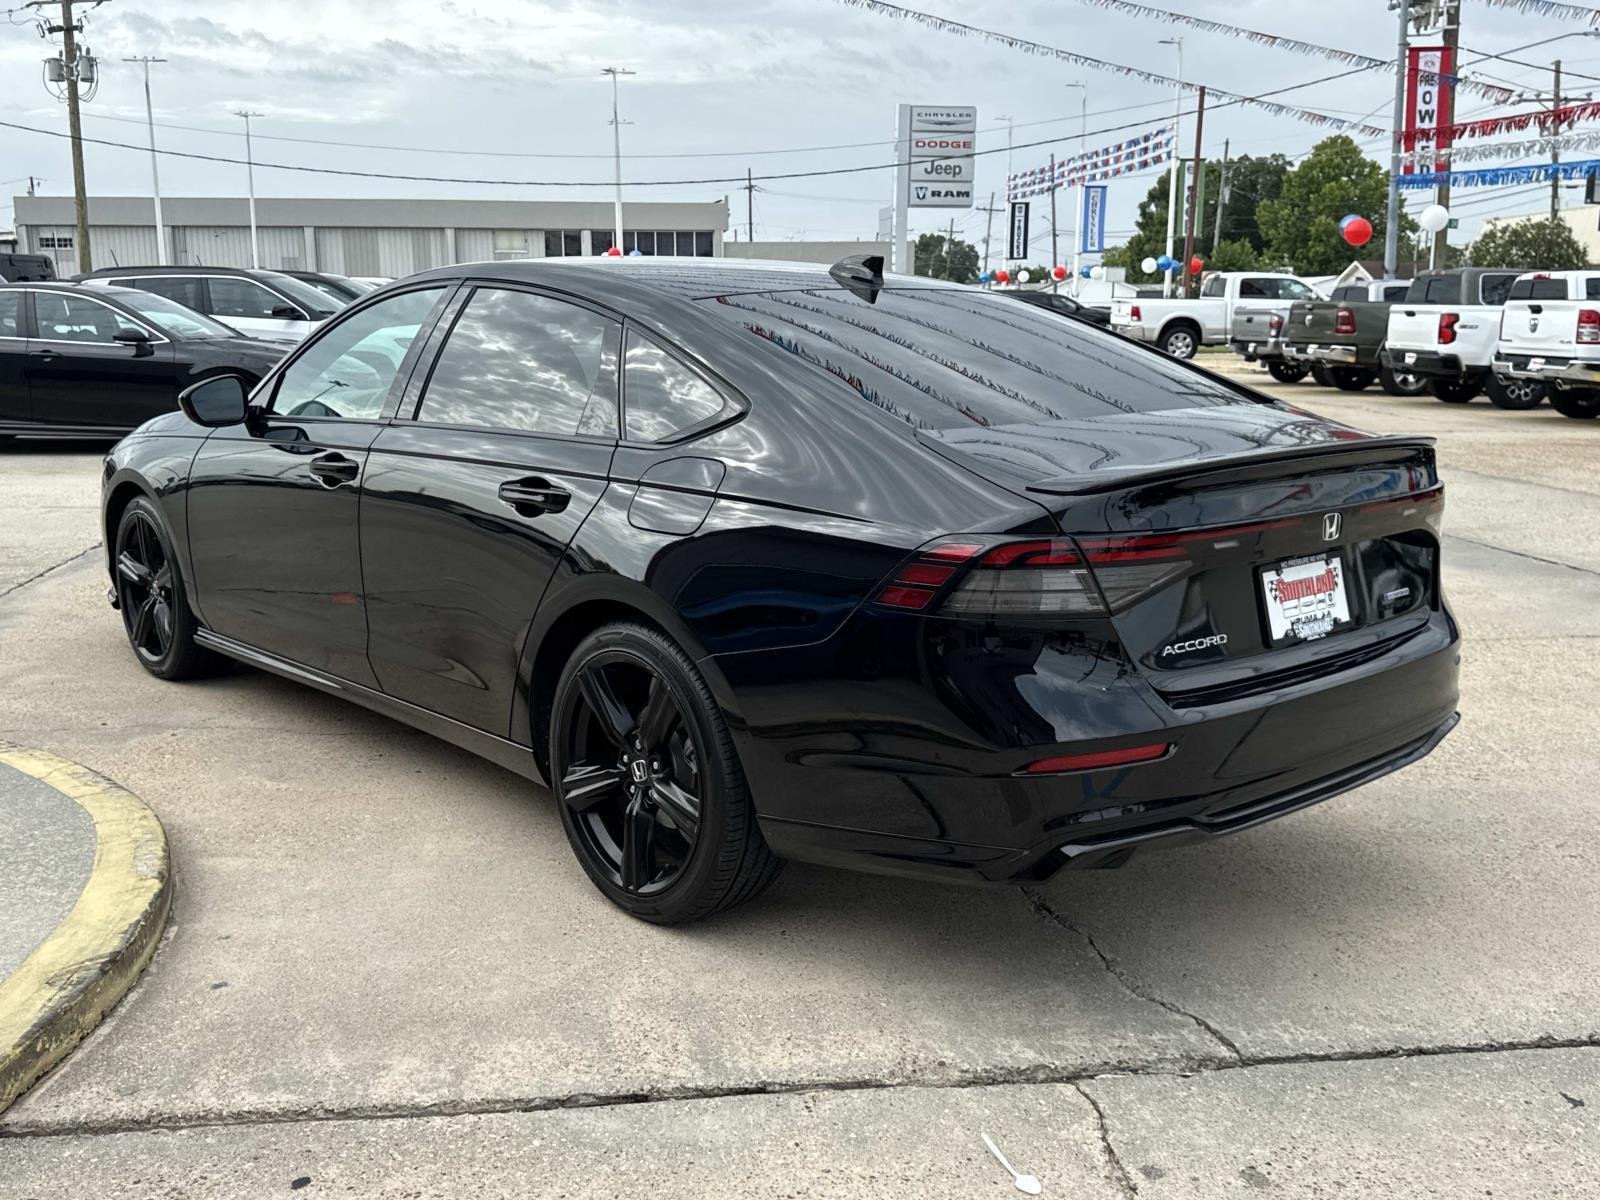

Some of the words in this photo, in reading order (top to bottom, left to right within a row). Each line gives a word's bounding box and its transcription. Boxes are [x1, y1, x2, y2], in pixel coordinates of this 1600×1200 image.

[915, 140, 973, 149] DODGE
[924, 160, 962, 178] Jeep
[931, 190, 971, 198] RAM
[1162, 634, 1228, 656] ACCORD
